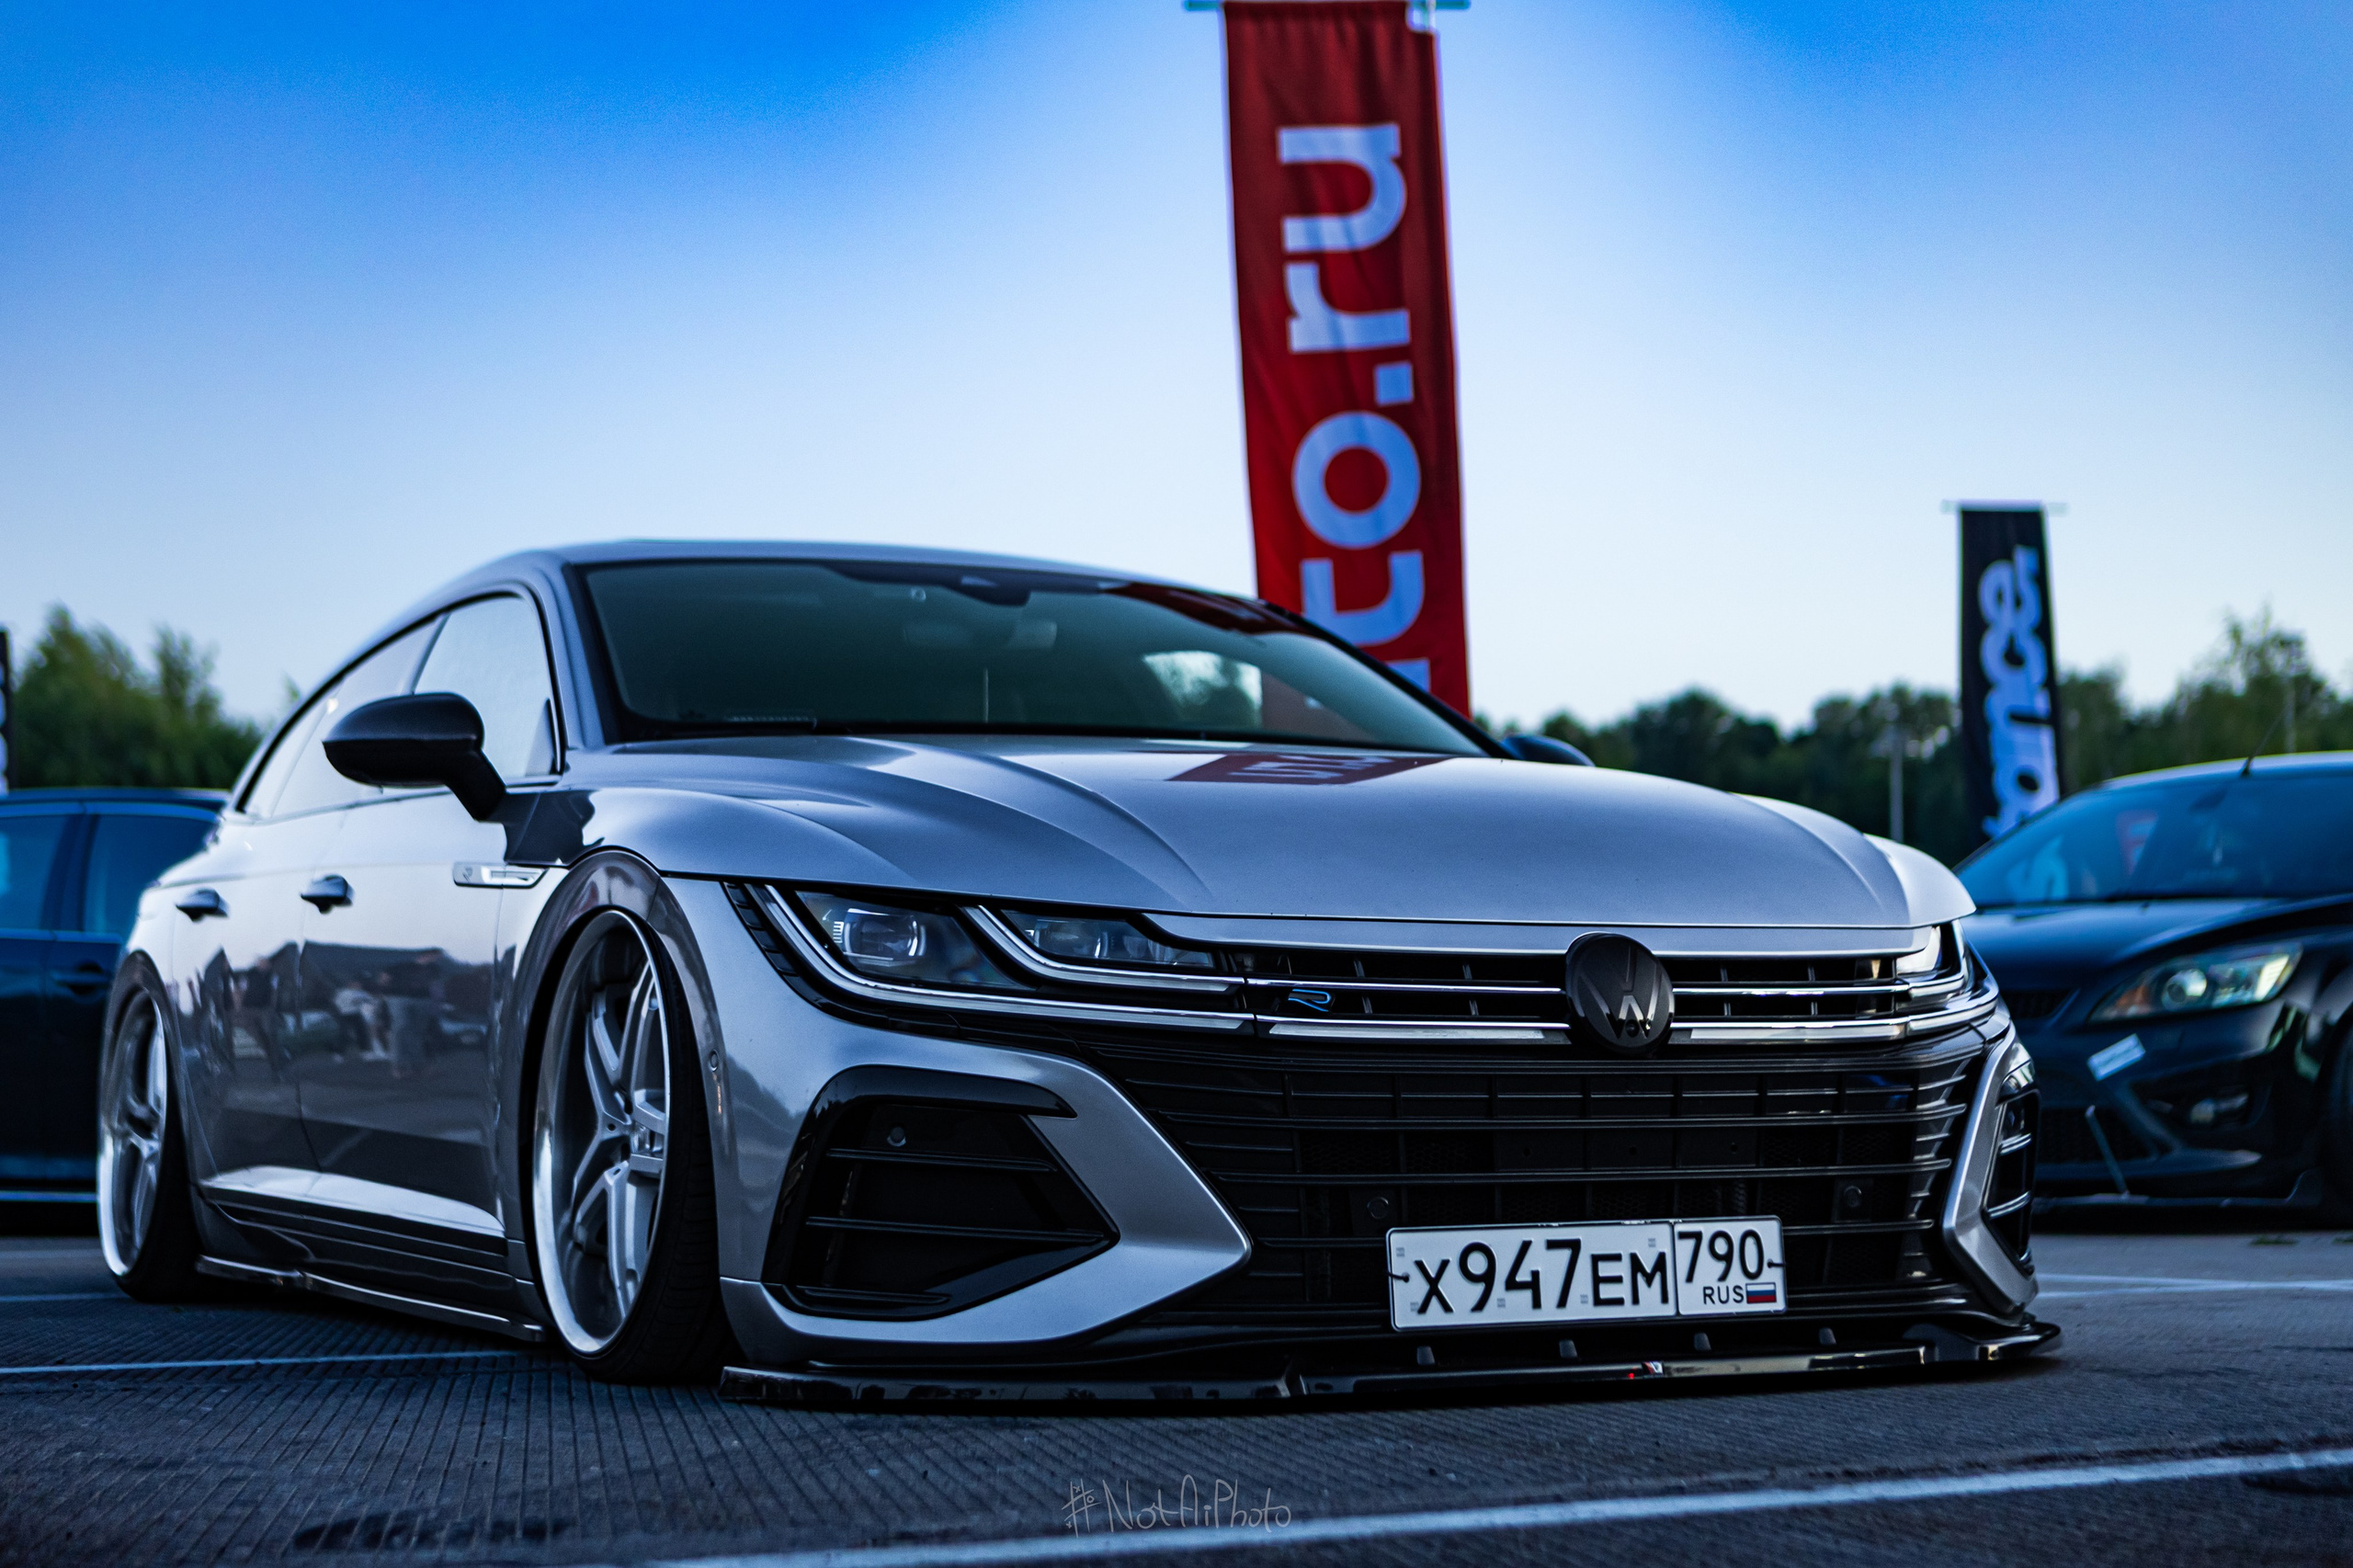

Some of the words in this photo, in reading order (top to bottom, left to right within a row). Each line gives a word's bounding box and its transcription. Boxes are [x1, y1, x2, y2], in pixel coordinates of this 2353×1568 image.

[1279, 123, 1430, 691] to.ru
[1677, 1229, 1765, 1284] 790
[1703, 1285, 1745, 1305] RUS
